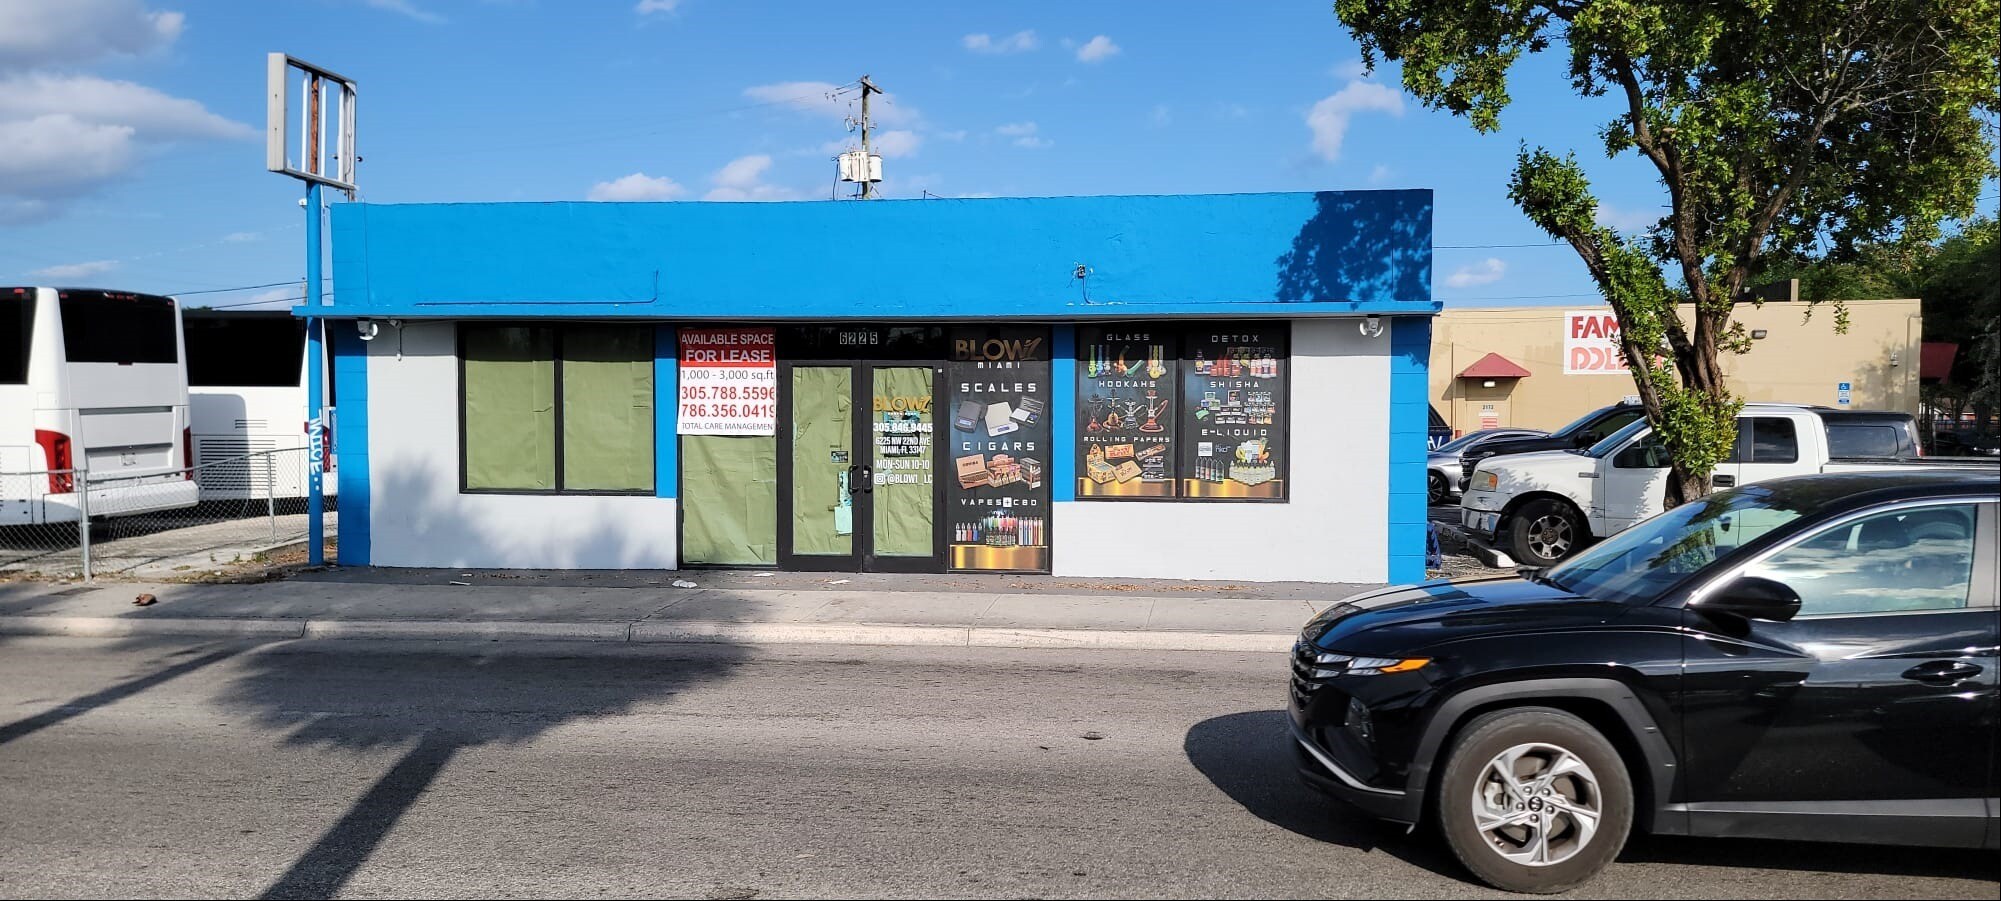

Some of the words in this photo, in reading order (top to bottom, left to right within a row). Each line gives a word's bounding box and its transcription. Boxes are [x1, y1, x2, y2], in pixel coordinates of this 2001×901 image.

[1571, 316, 1620, 339] FAM
[681, 334, 738, 345] AVAILABLE
[739, 334, 774, 345] SPACE
[839, 331, 878, 345] 6225
[1106, 333, 1150, 341] GLASS
[1211, 335, 1260, 343] DETOX
[685, 349, 717, 363] FOR
[720, 349, 770, 363] LEASE
[977, 361, 1021, 369] MIAMI
[681, 370, 710, 380] 1,000
[719, 370, 748, 381] 3,000
[751, 370, 774, 382] sq.ft
[961, 382, 1037, 393] SCALES
[1098, 380, 1157, 388] HOOKAHS
[681, 386, 775, 400] 305.788.5596
[681, 404, 775, 418] 786.356.0419
[704, 422, 723, 430] CARE
[724, 422, 773, 431] MANAGEMEN
[875, 436, 891, 445] 6225
[891, 436, 902, 446] NW
[902, 436, 919, 446] 22ND
[919, 436, 932, 446] AVE
[962, 441, 1035, 451] CIGARS
[901, 445, 908, 454] FL
[908, 445, 926, 454] 33147
[876, 460, 910, 470] MON-SUN
[911, 460, 930, 470] 10-10
